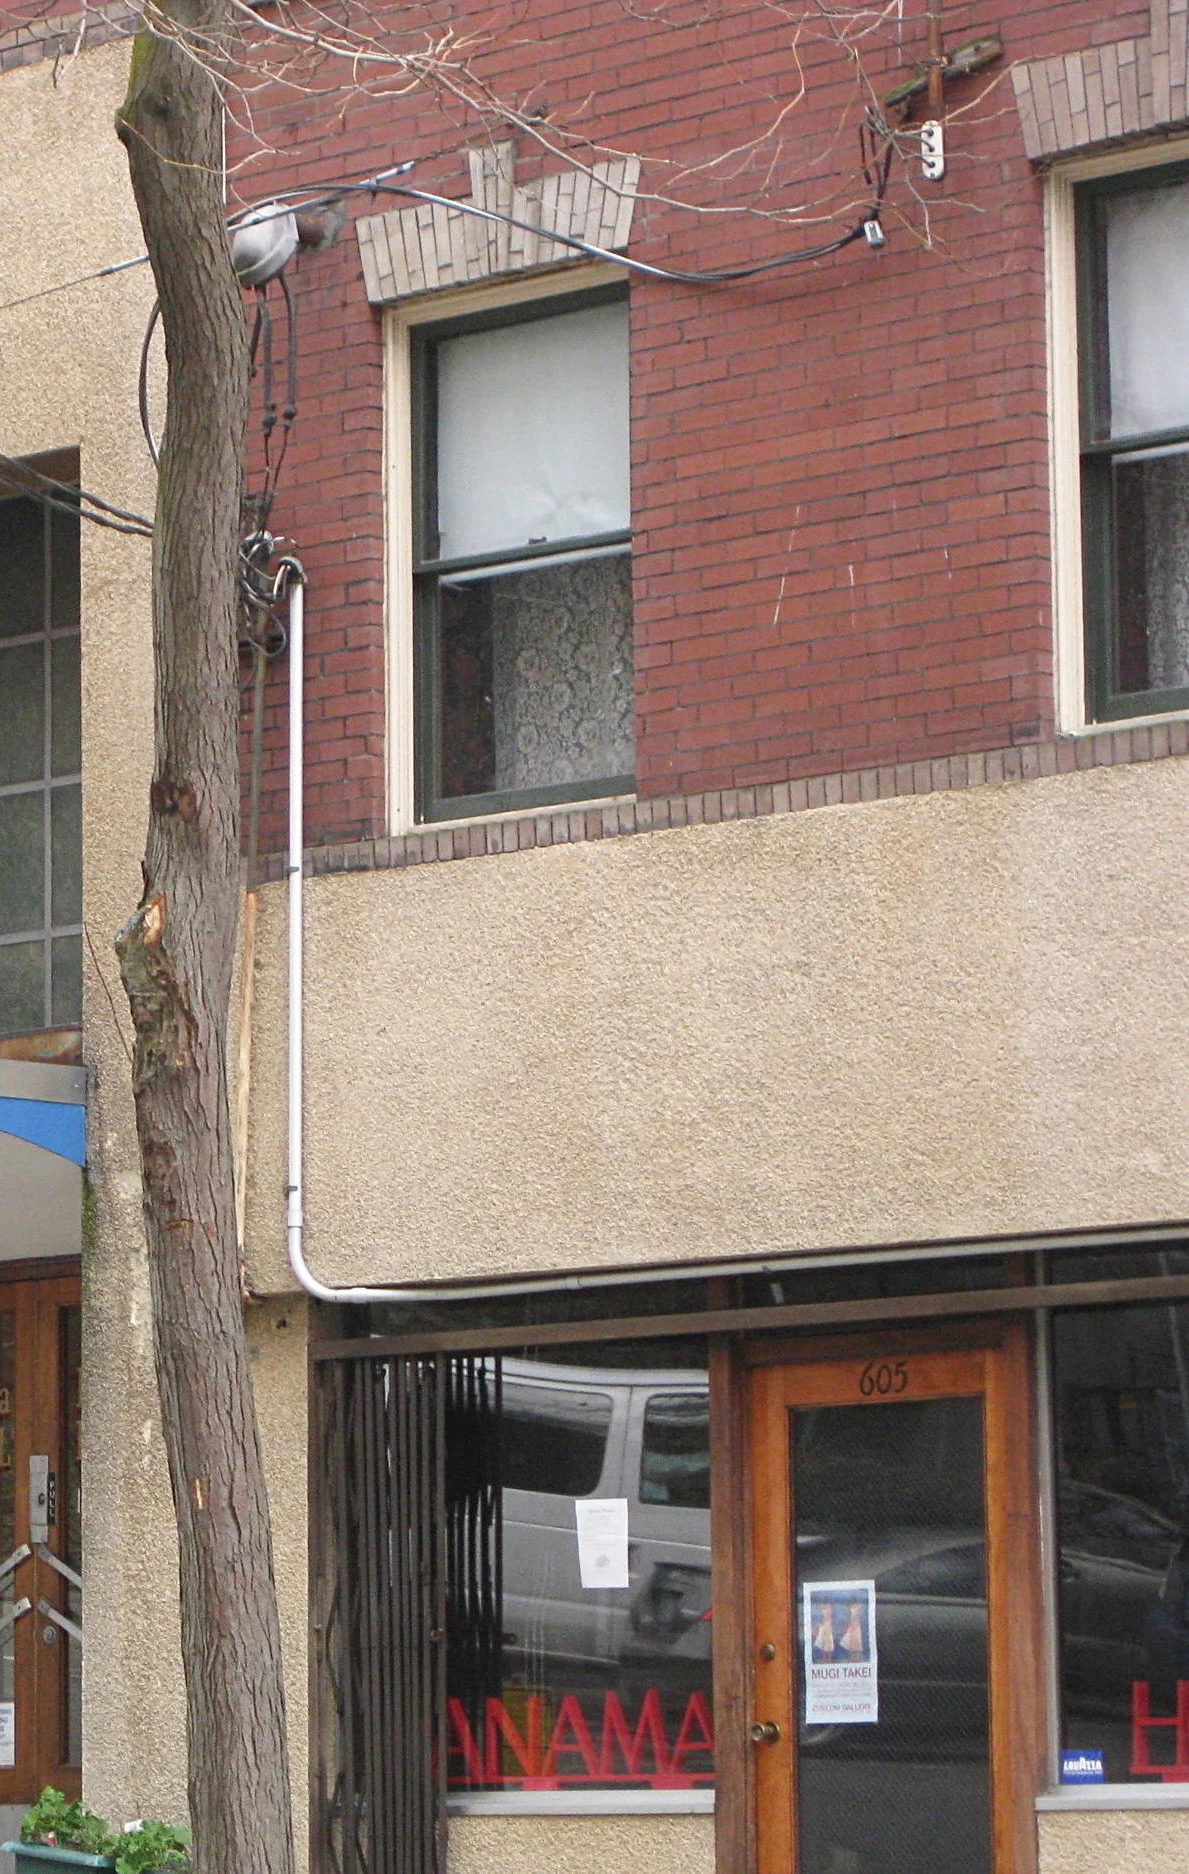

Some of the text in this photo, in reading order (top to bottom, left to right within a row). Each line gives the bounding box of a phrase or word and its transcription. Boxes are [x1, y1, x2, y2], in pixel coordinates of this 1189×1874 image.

[859, 1359, 907, 1395] 605
[811, 1667, 871, 1679] MUGI TAKEI
[1063, 1757, 1102, 1770] LAVAZZA
